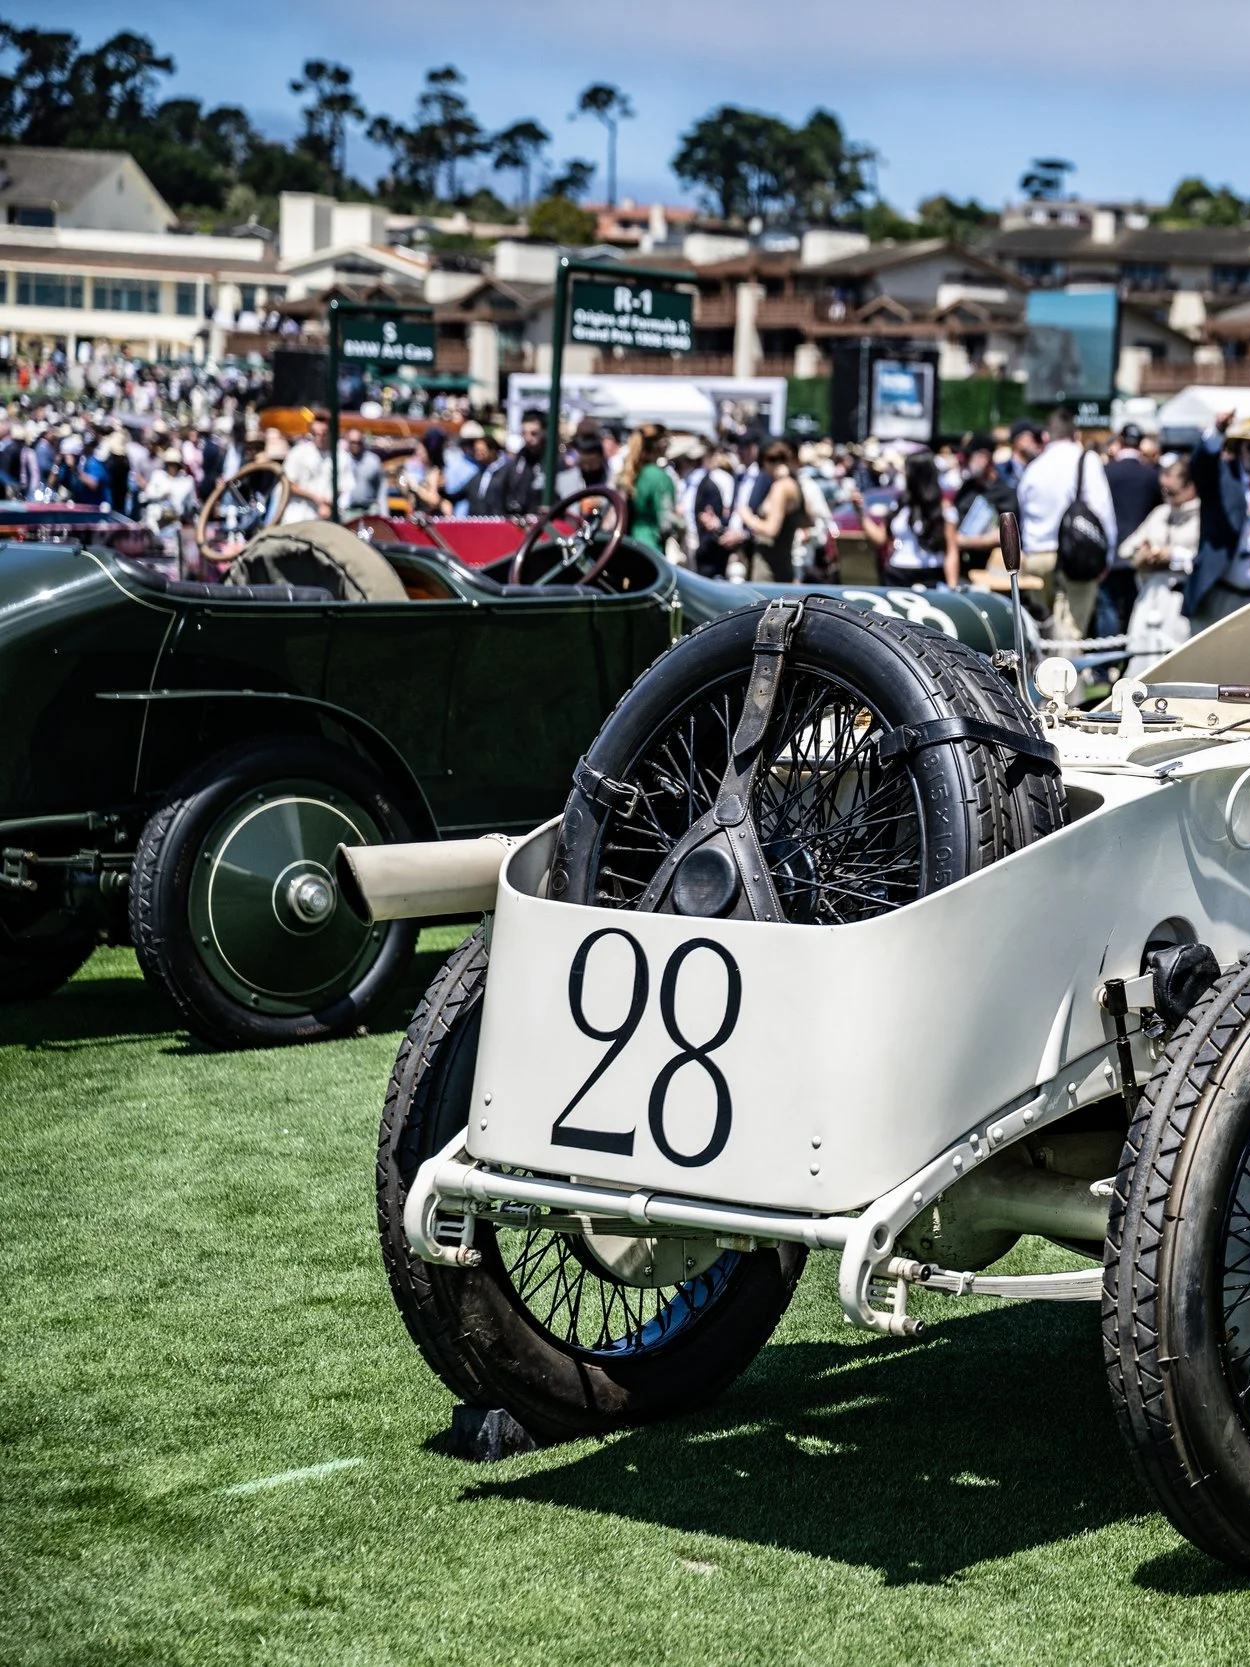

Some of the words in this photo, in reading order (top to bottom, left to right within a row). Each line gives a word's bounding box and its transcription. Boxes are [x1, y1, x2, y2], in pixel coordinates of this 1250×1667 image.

[614, 286, 653, 315] R-1
[382, 321, 398, 343] S
[573, 308, 616, 328] Origins
[616, 313, 630, 330] of
[630, 313, 677, 334] Formula
[572, 324, 609, 342] Grand
[611, 327, 634, 345] Prix
[344, 338, 380, 358] BMW
[381, 342, 404, 360] Art
[403, 342, 434, 361] Cars
[550, 927, 742, 1168] 28
